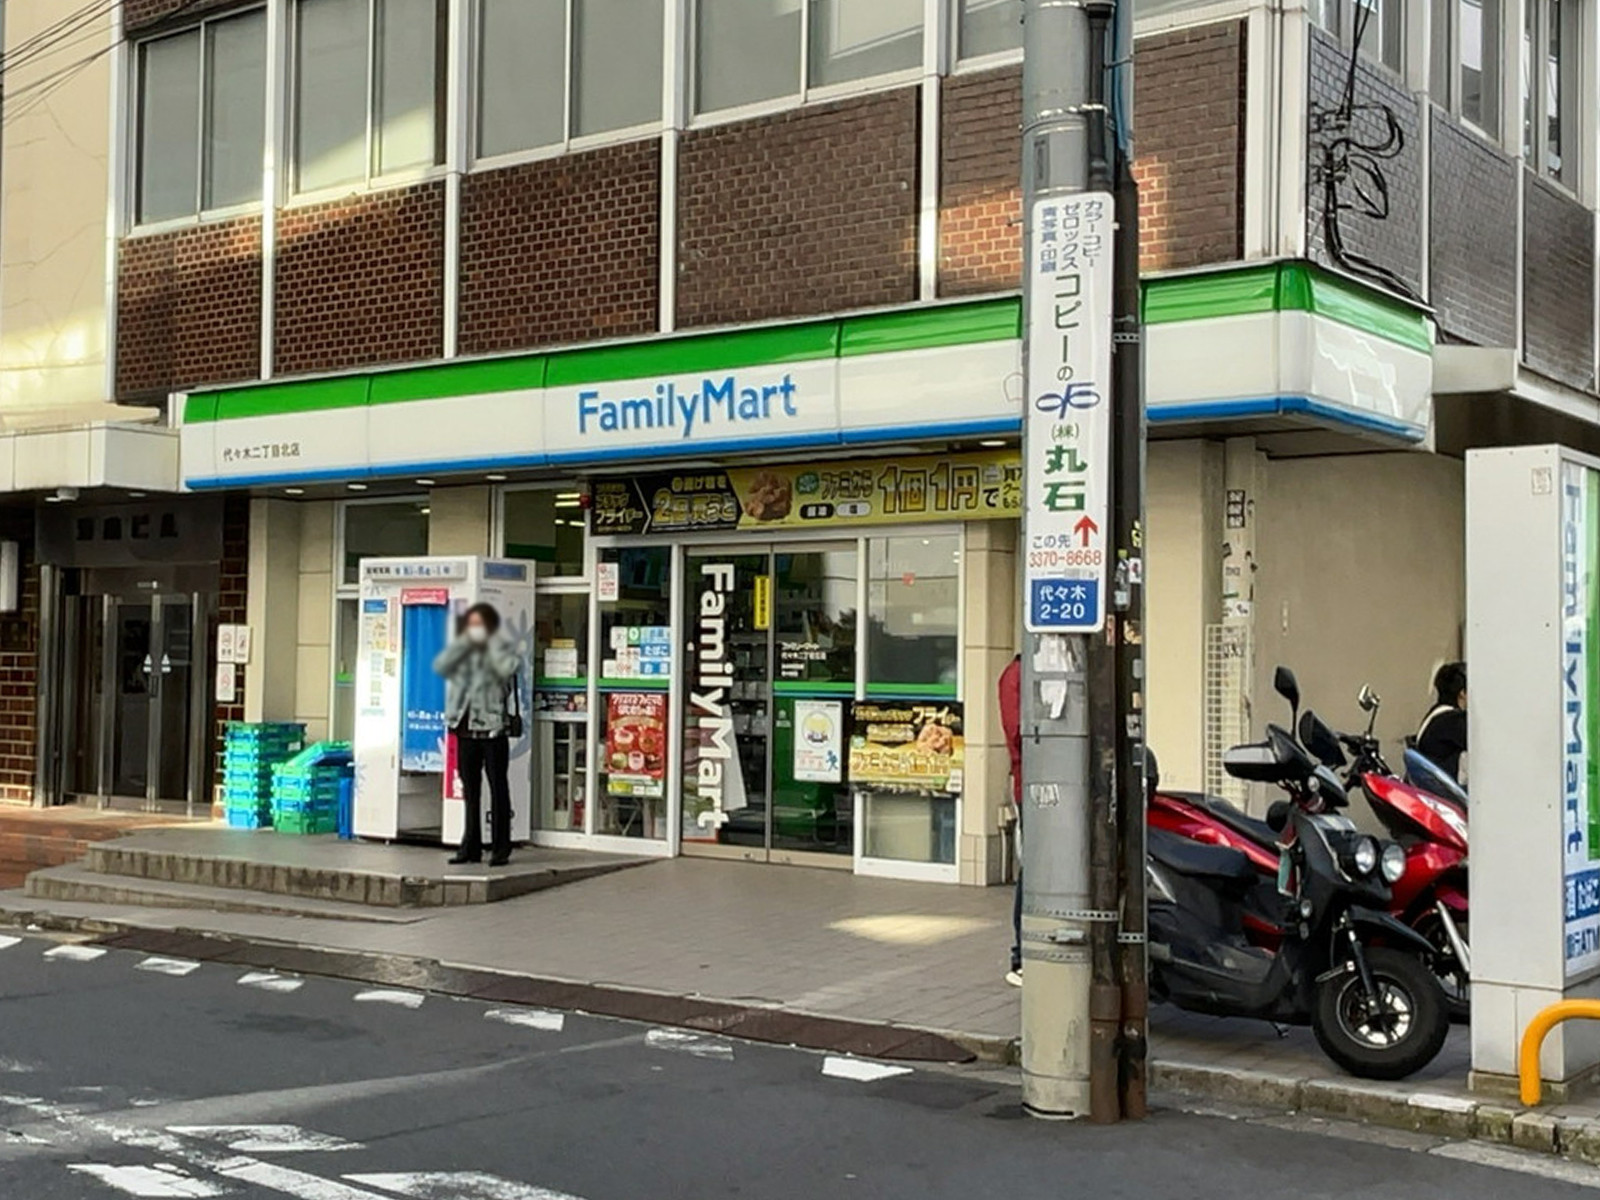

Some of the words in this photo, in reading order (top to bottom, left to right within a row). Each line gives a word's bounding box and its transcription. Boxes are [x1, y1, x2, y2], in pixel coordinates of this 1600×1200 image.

[1061, 202, 1080, 270] ゼロックス
[1083, 200, 1103, 268] カラーコピー
[1054, 273, 1082, 382] コピーの
[578, 374, 797, 438] FamilyMart
[223, 442, 300, 461] 代々木二丁目北店
[1043, 445, 1088, 512] 丸石
[1029, 550, 1102, 567] 3370-8668
[1032, 534, 1071, 549] この先
[1039, 585, 1087, 601] 代々木
[1040, 602, 1085, 619] 2-20
[690, 564, 734, 829] FamilyMart
